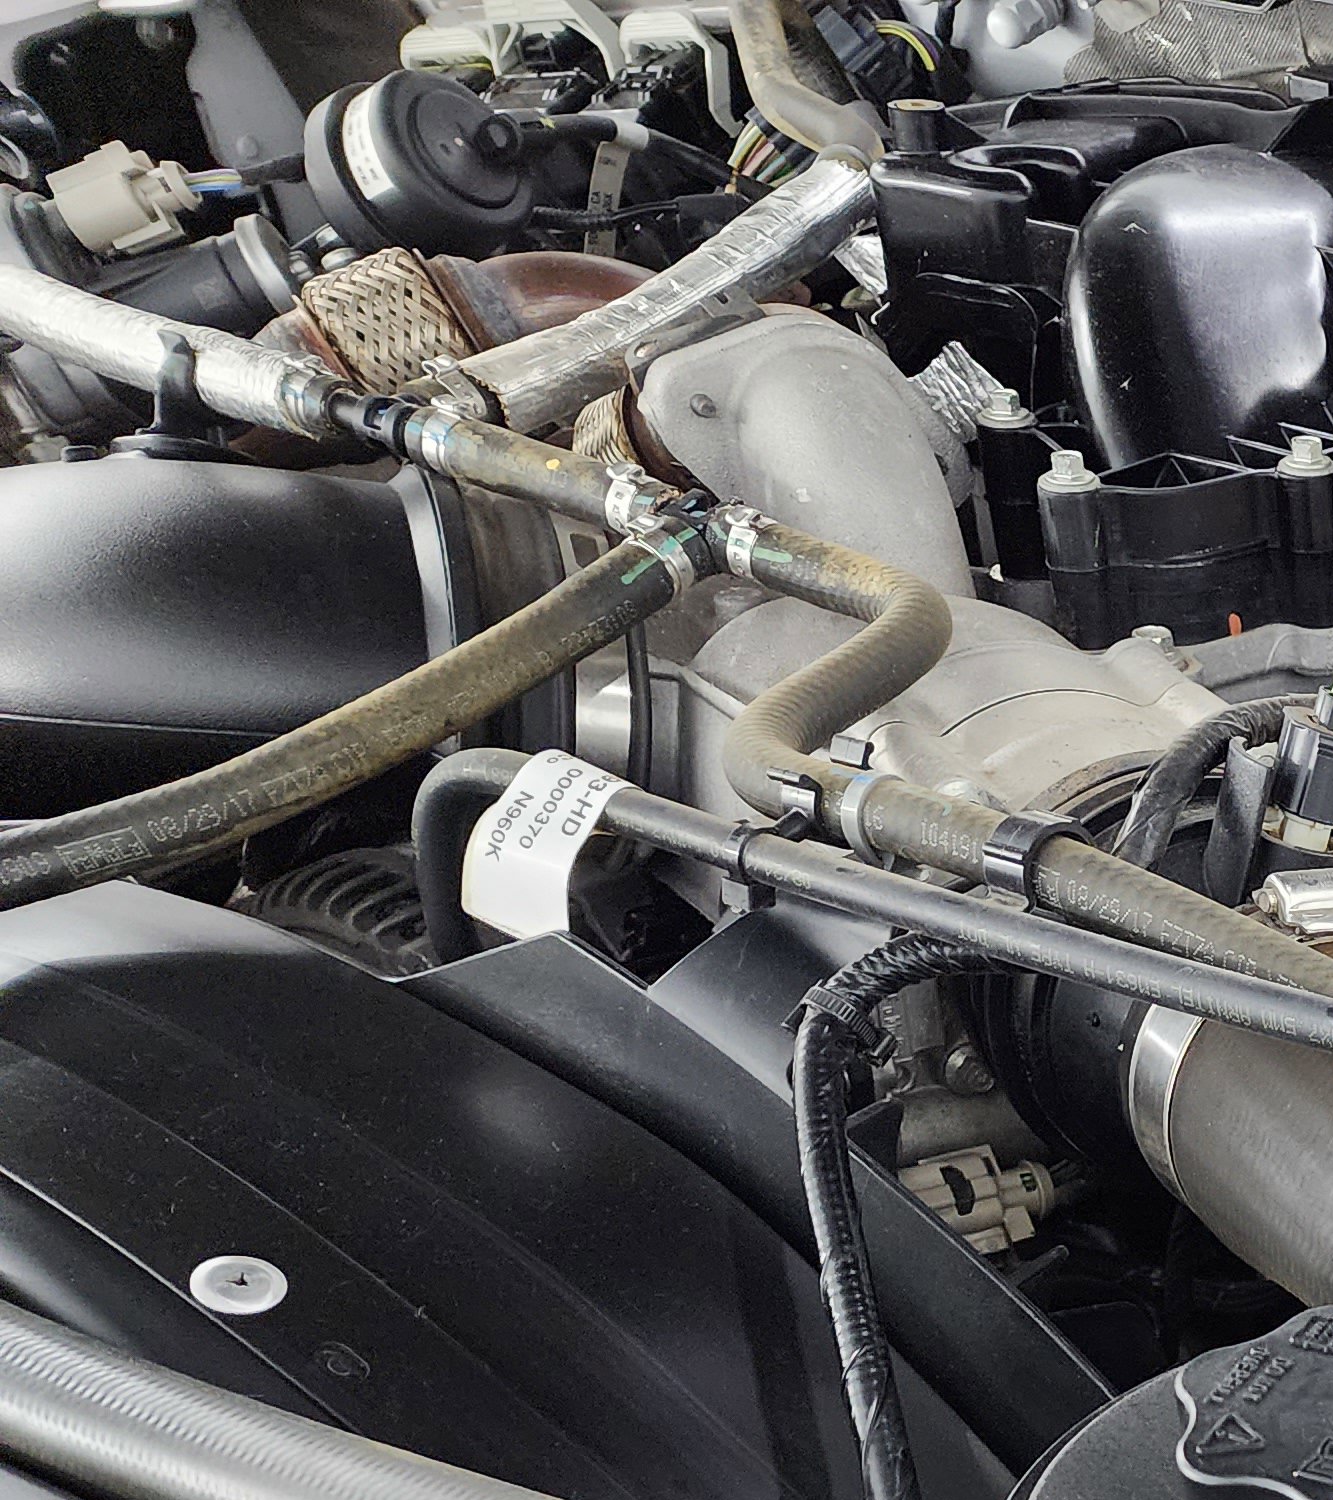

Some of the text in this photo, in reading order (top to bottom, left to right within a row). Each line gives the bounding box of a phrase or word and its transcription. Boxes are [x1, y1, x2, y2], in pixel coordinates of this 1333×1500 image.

[485, 790, 535, 862] N960K
[520, 767, 583, 850] 0000370
[956, 923, 991, 946] DOT
